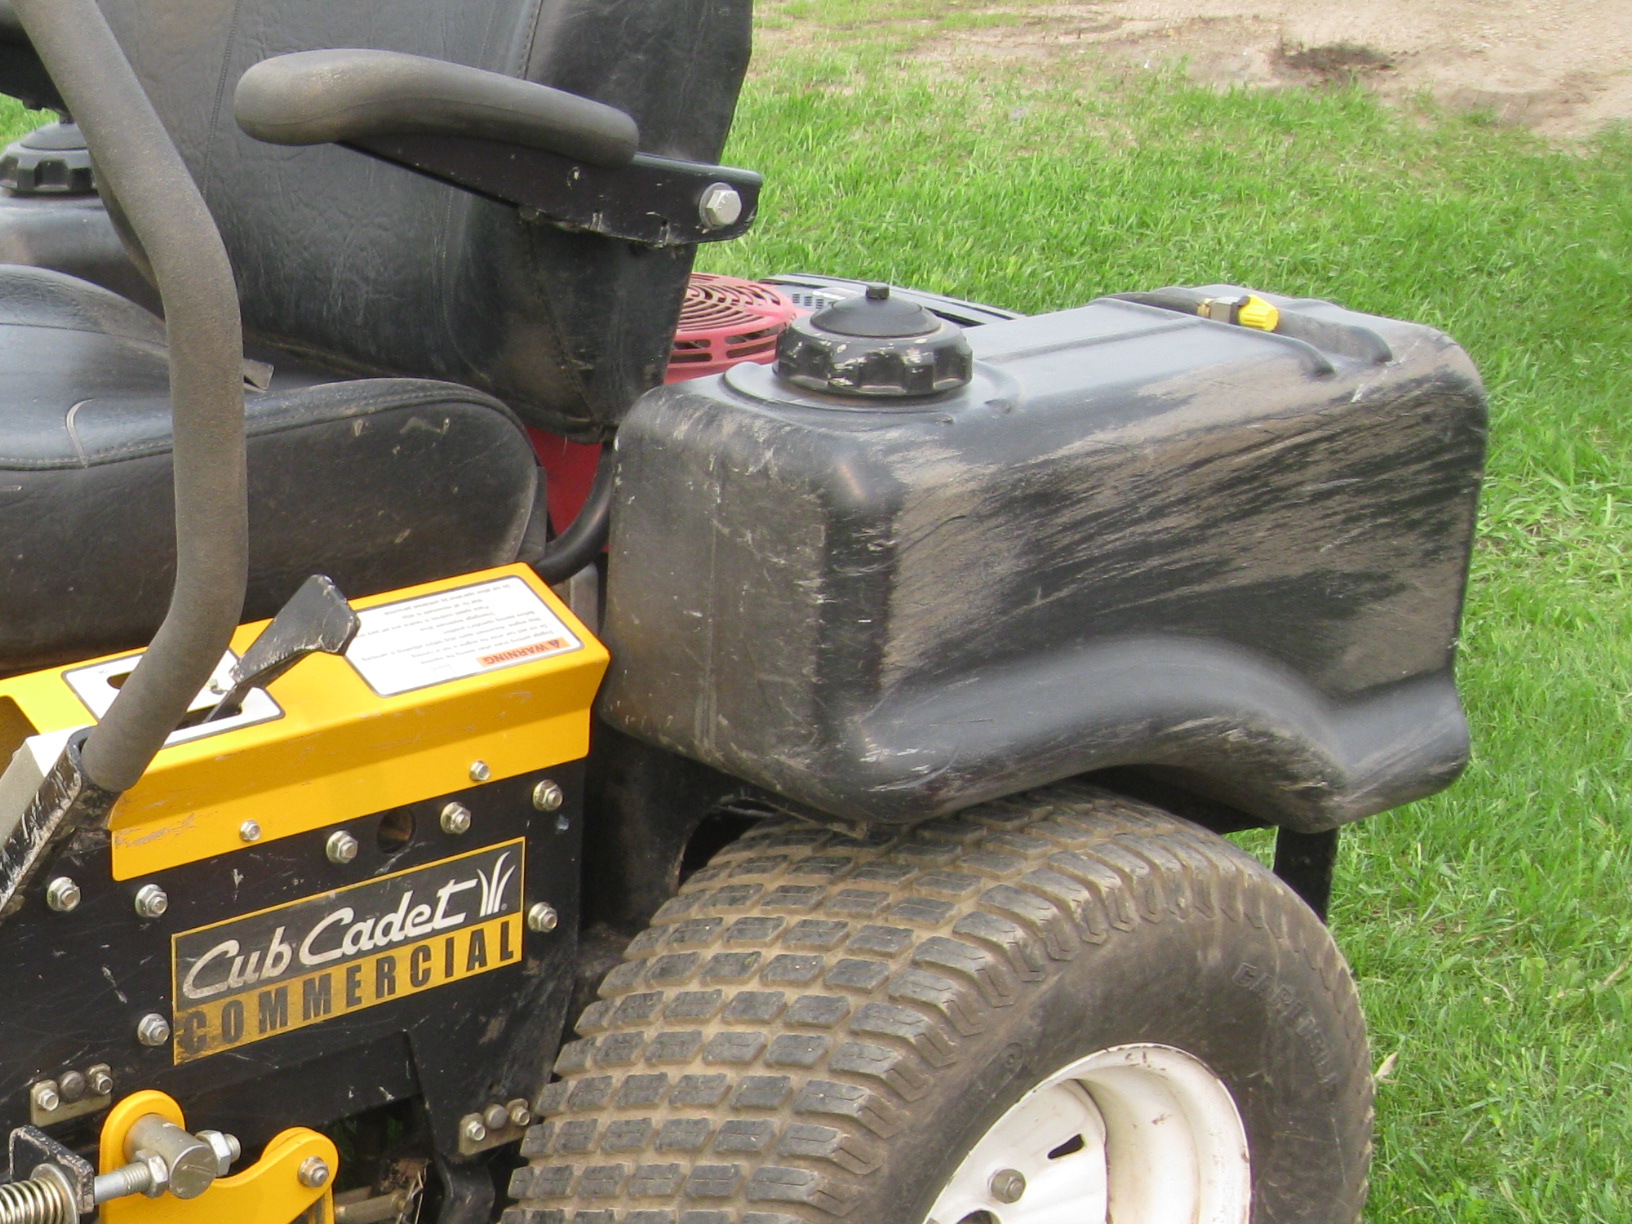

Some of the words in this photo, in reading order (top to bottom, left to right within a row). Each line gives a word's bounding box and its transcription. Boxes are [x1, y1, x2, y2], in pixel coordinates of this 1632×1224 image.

[481, 642, 549, 665] WARNING
[177, 919, 515, 1055] COMMERCIAL
[183, 925, 293, 1000] Cub
[299, 877, 478, 966] Cadet
